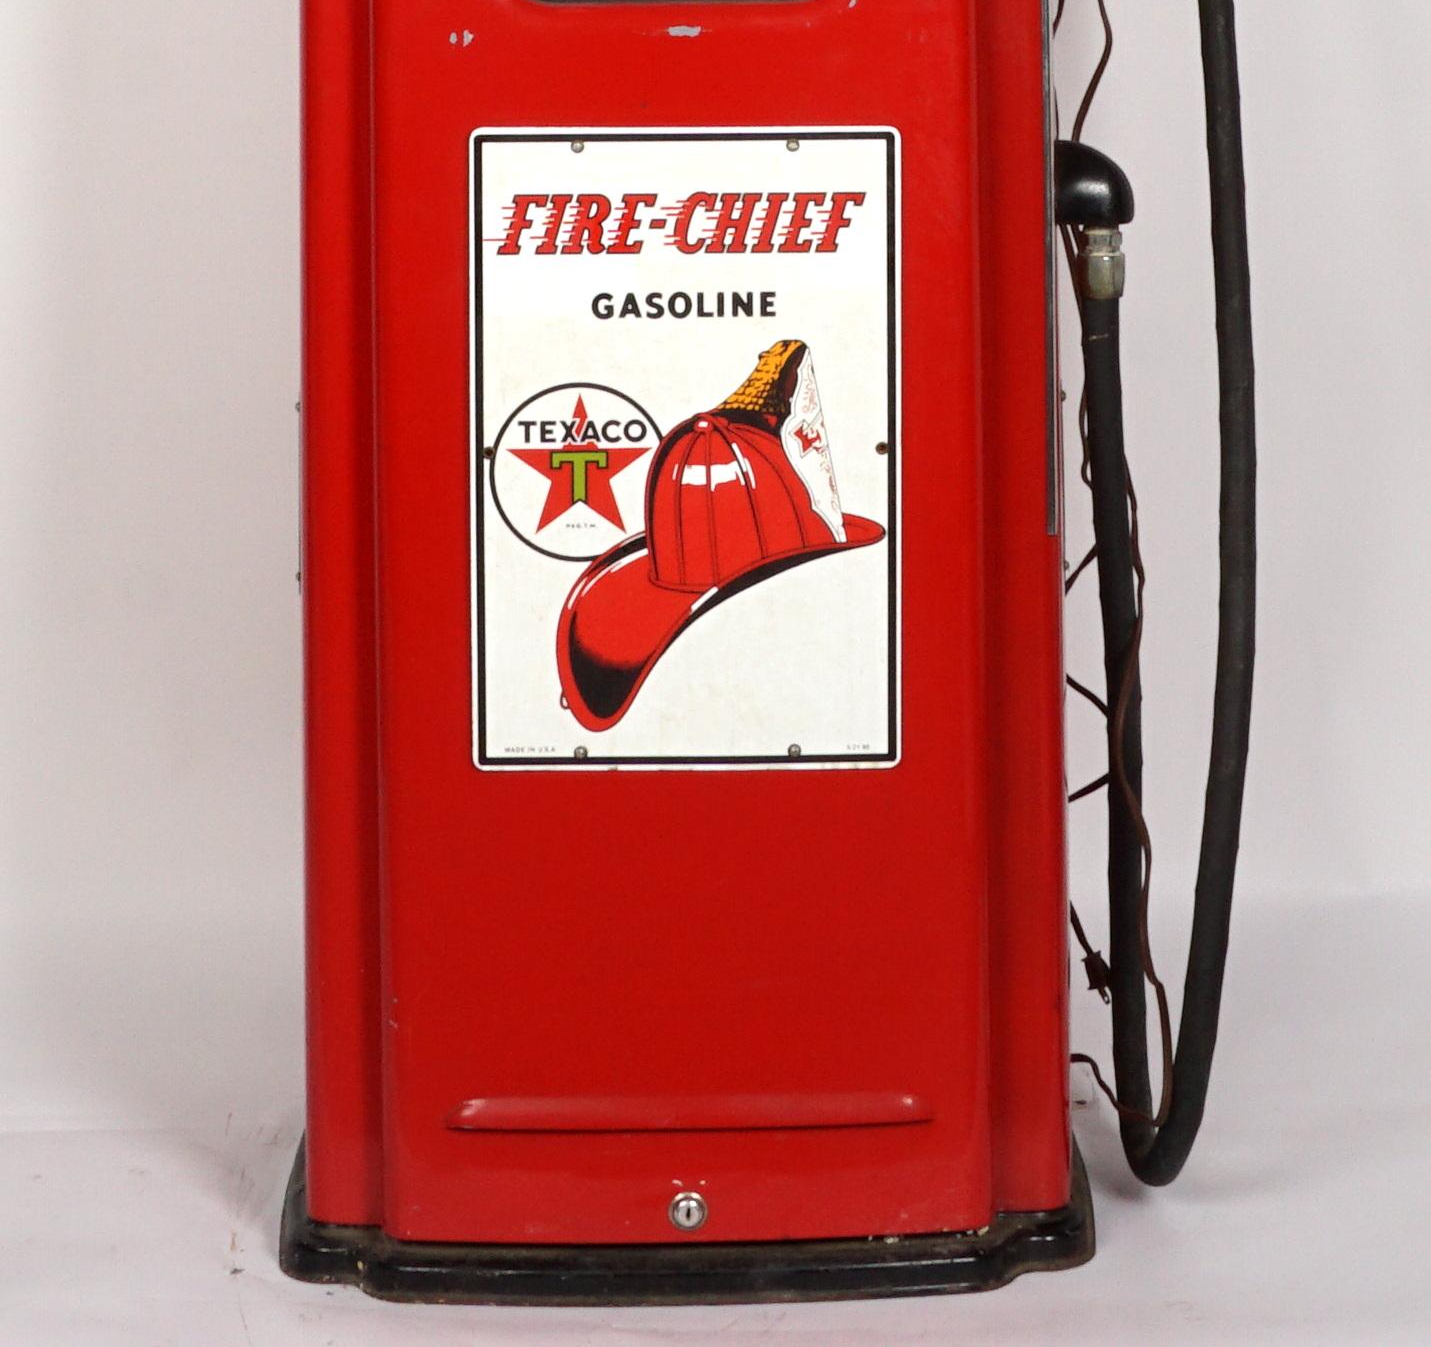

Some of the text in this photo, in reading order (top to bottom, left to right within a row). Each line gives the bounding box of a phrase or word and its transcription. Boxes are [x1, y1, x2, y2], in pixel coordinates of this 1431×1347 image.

[483, 192, 866, 256] FIRE-CHIEF
[592, 292, 777, 319] GASOLINE
[518, 420, 647, 443] TEXACO
[550, 451, 608, 505] T
